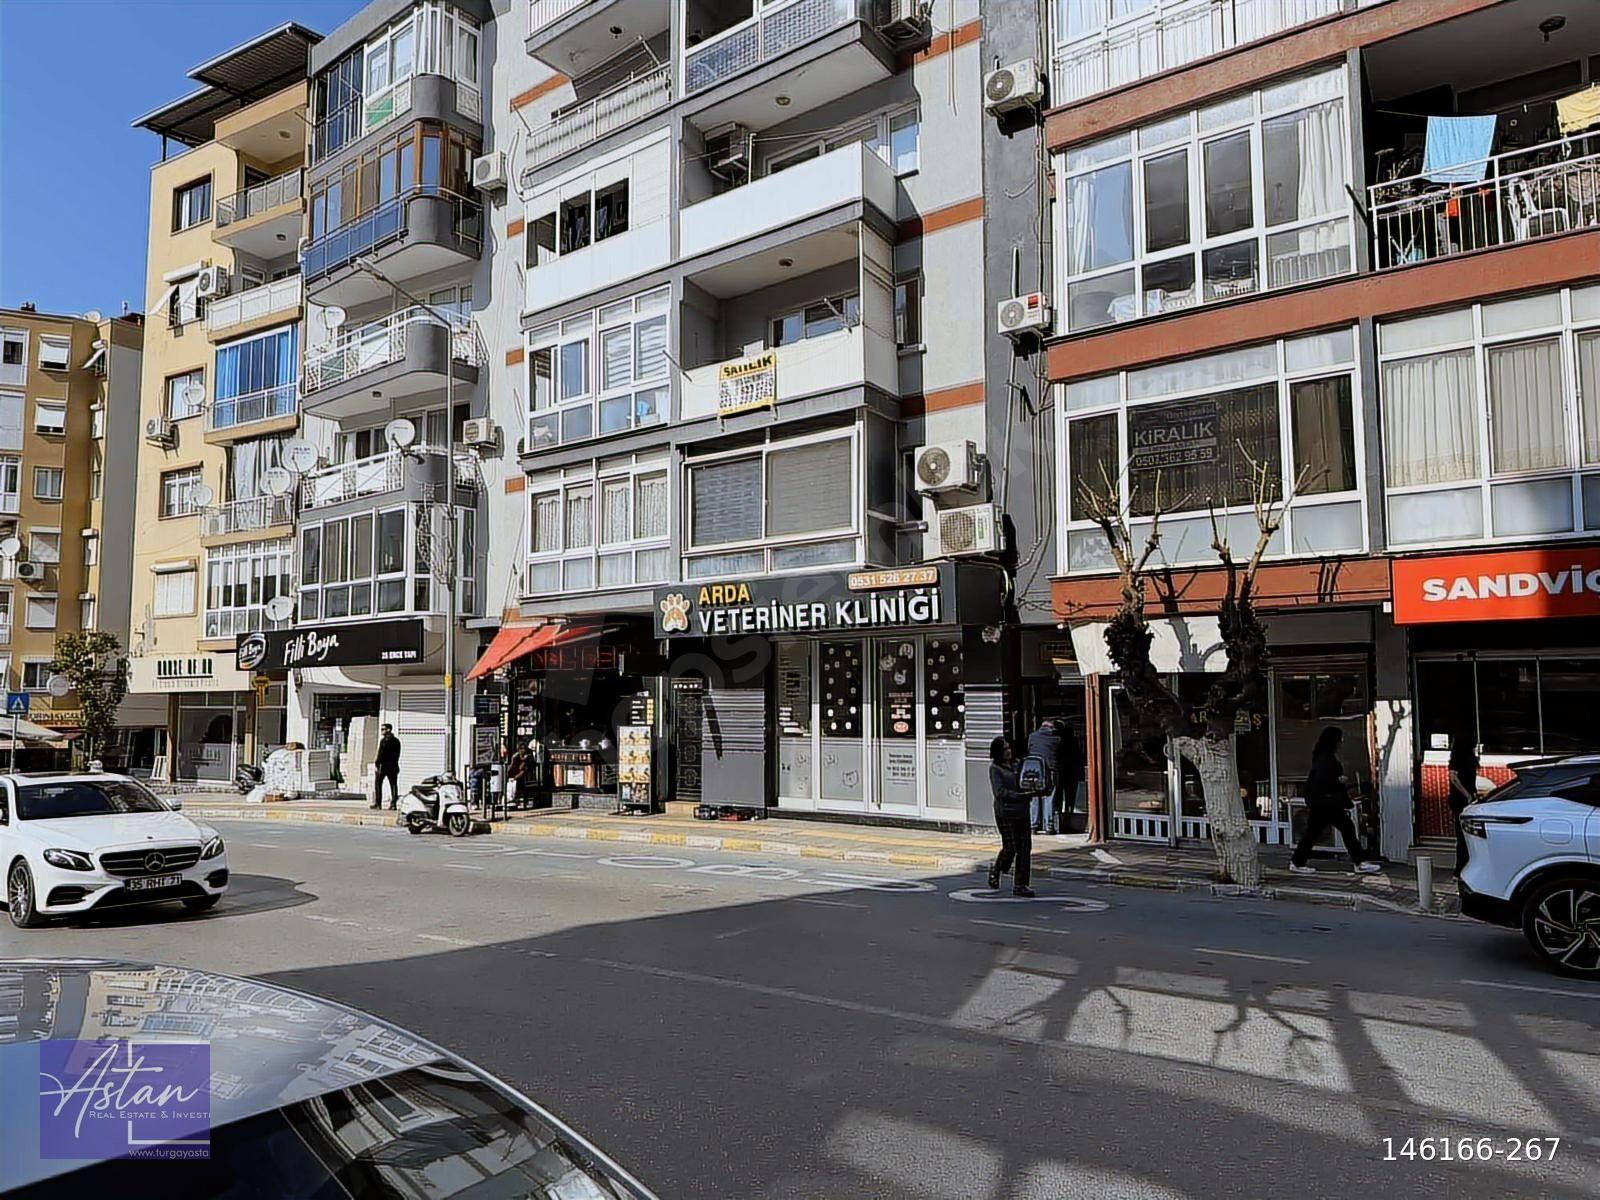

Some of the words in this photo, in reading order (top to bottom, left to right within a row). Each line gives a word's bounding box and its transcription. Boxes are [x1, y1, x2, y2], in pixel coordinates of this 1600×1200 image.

[851, 576, 877, 587] 0531
[903, 571, 918, 582] 27
[920, 570, 934, 581] 37
[698, 582, 751, 605] ARDA
[698, 599, 827, 635] VETERİNER
[834, 587, 939, 625] KLİNİĞİ
[307, 631, 340, 661] Boya
